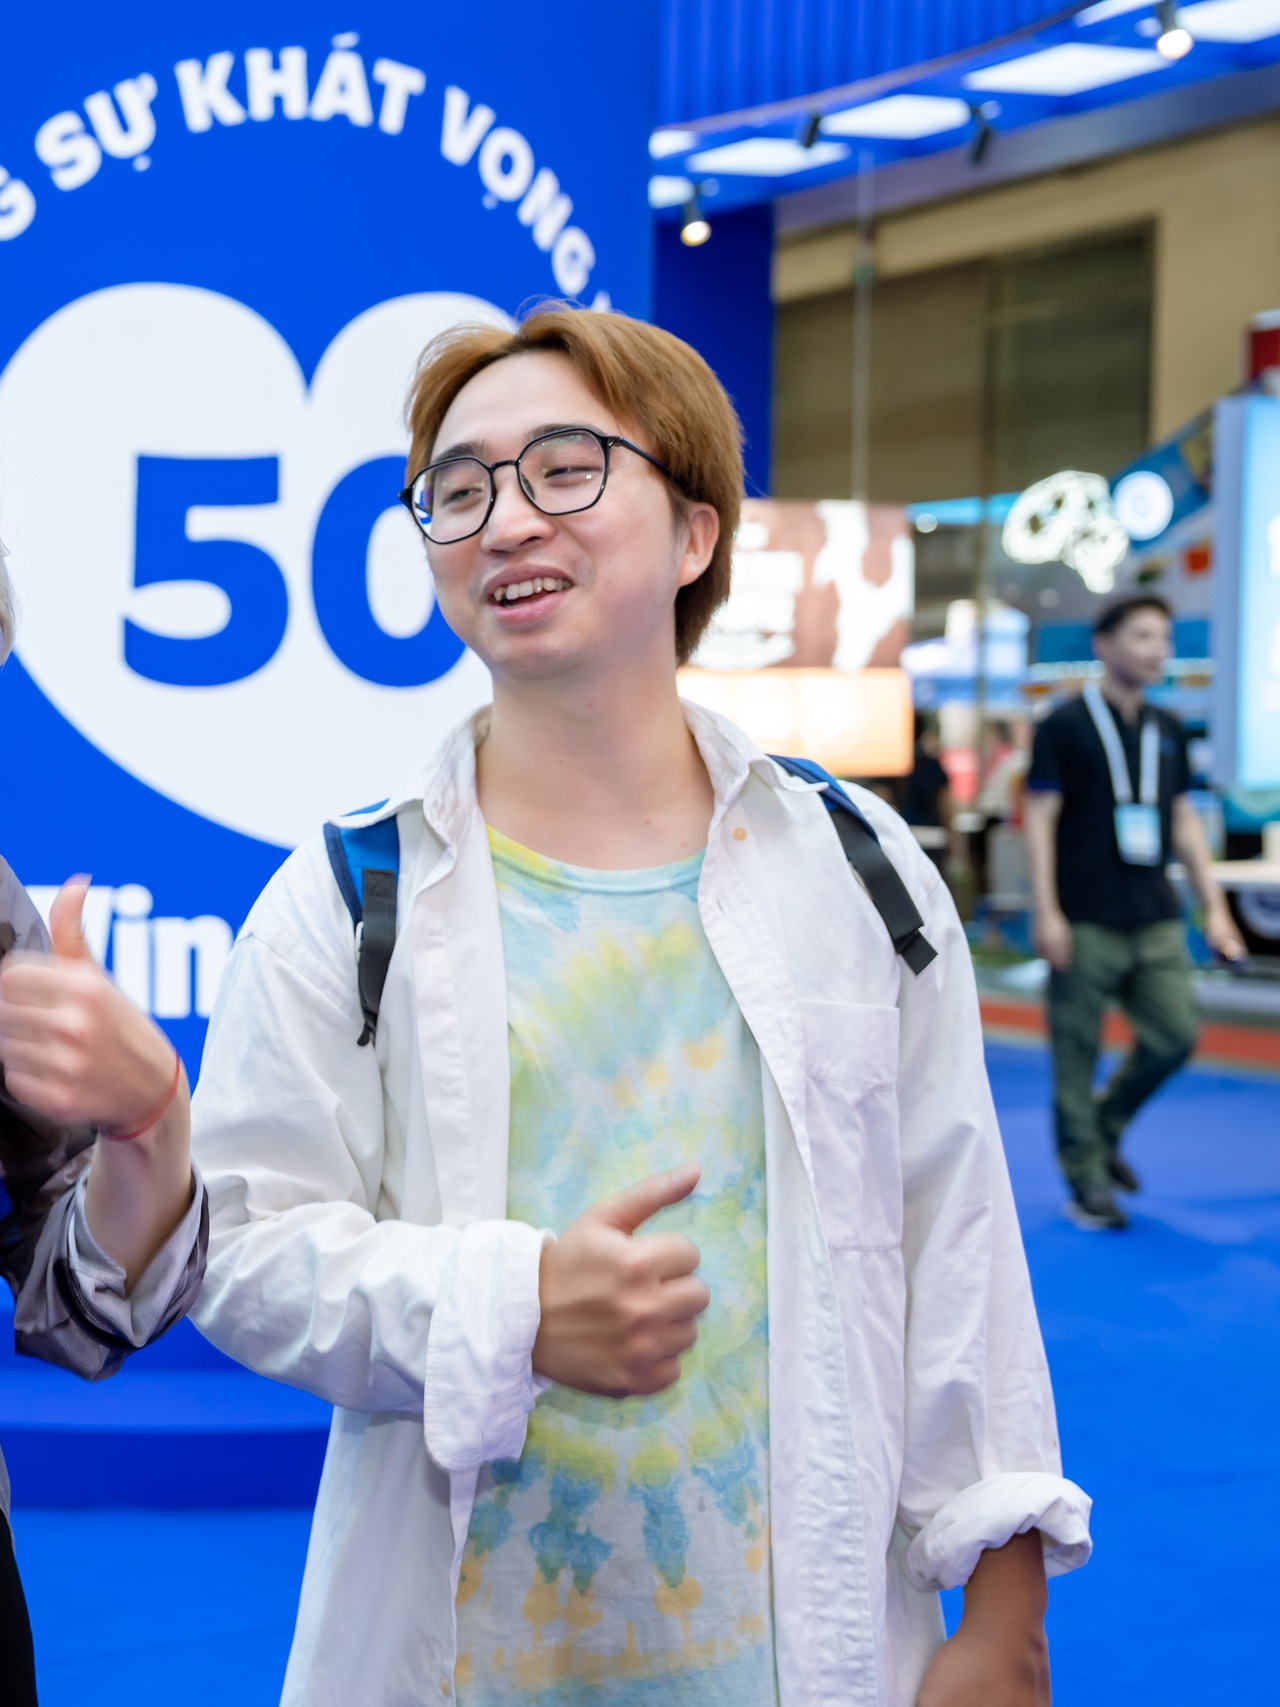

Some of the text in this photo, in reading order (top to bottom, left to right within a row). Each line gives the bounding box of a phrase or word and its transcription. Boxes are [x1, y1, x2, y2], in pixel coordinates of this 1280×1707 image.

[33, 72, 159, 192] SỰ
[173, 31, 427, 136] KHÁT
[439, 84, 596, 297] VỌNG
[122, 452, 467, 688] 50
